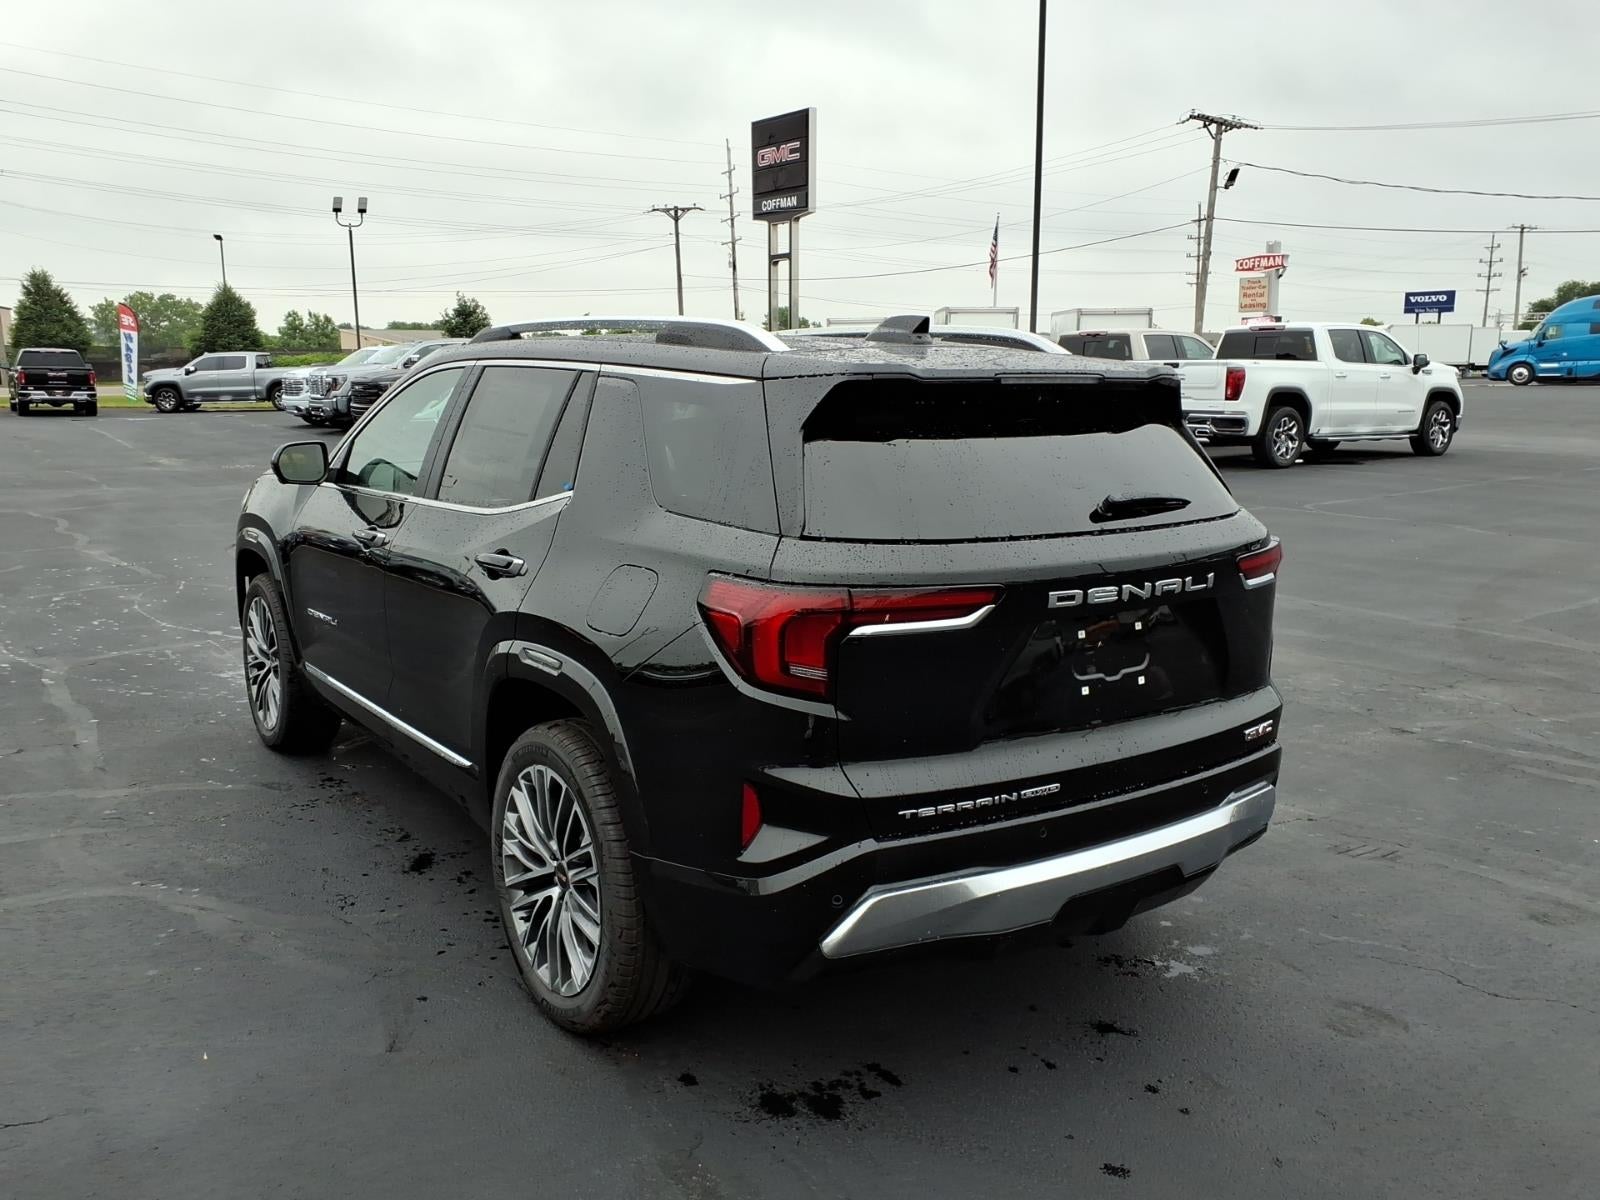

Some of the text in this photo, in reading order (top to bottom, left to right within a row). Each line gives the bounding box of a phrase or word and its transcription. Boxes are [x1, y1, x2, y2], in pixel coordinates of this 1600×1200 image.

[757, 141, 800, 167] GMC
[761, 196, 797, 211] COFFMAN
[1237, 255, 1282, 270] COFFMAN
[1243, 291, 1265, 299] Rental
[1409, 294, 1447, 303] VOLVO
[1048, 572, 1215, 608] DENALI
[898, 792, 1018, 820] TERRAIN
